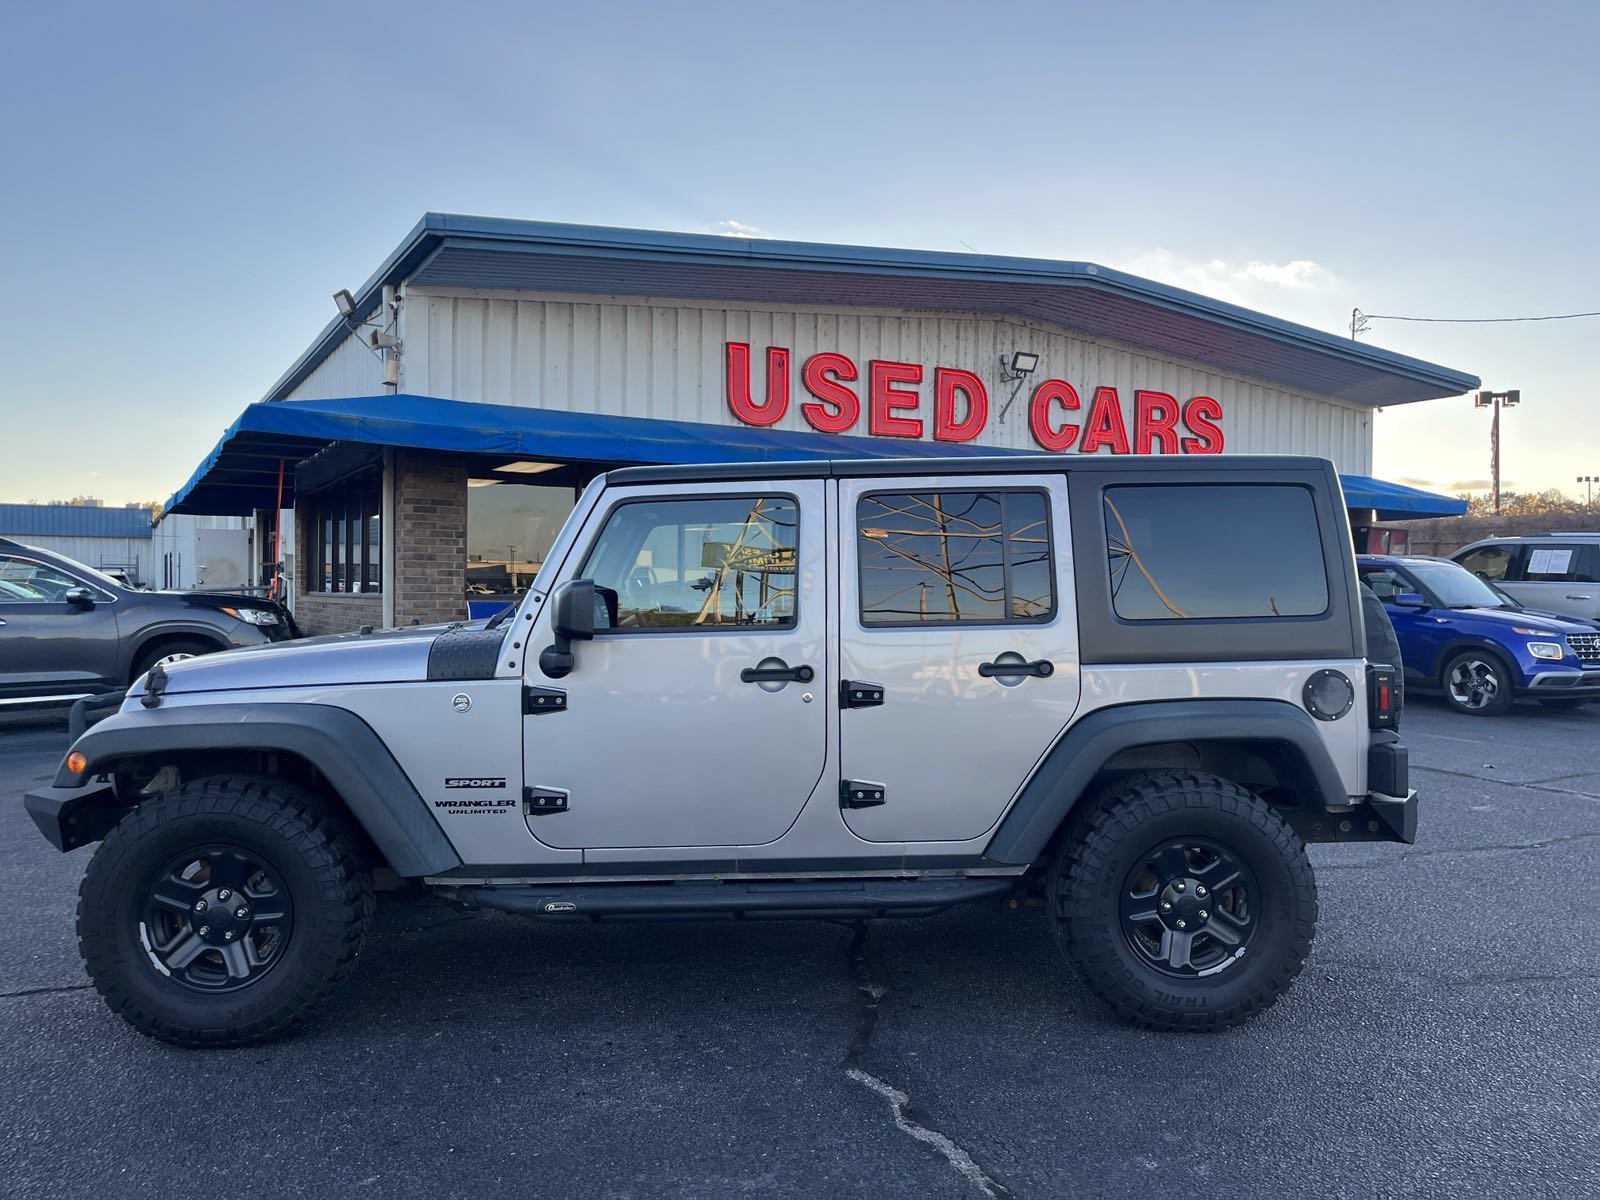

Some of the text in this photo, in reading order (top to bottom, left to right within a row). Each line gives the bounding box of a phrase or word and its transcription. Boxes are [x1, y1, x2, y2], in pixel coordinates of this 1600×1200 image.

[725, 341, 1225, 455] USED CARS
[446, 778, 505, 788] SPORT
[435, 800, 516, 808] WRANGLER
